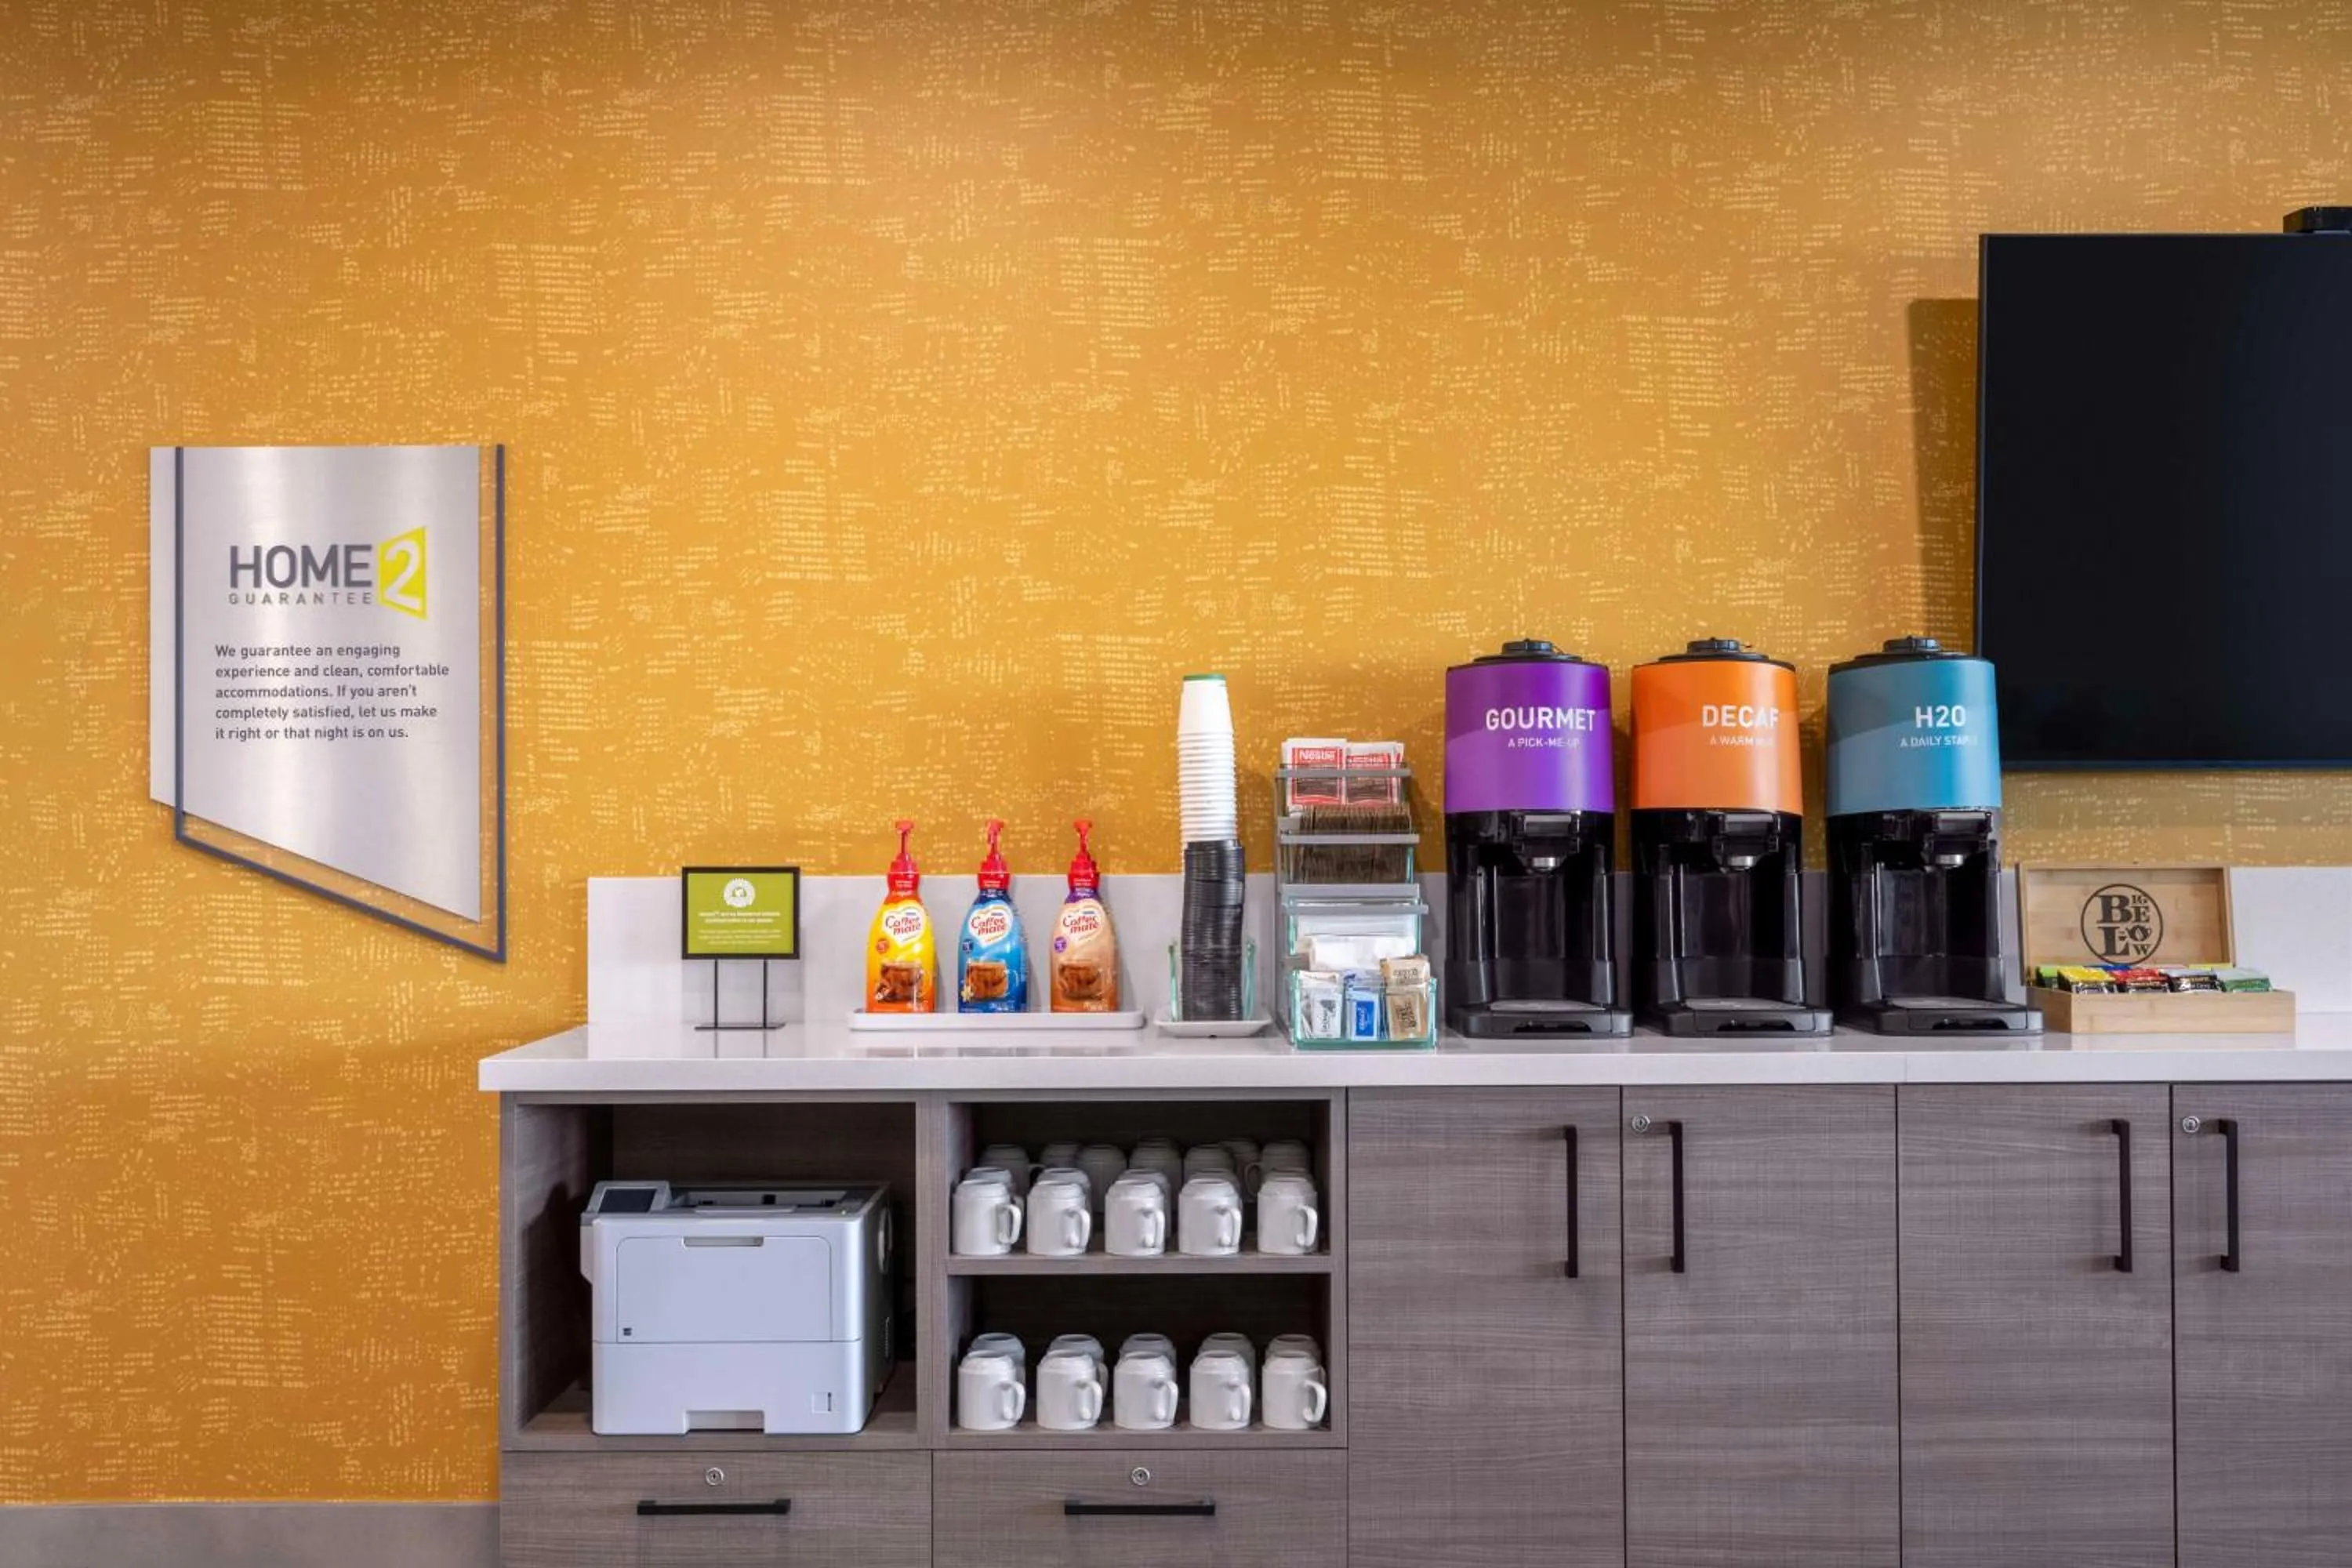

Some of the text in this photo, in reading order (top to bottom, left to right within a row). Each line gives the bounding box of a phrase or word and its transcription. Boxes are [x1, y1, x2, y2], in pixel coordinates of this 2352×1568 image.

[230, 545, 372, 589] HOME
[229, 592, 372, 604] GUARANTEE
[216, 644, 401, 659] We guarantee an engaging
[216, 663, 449, 680] experience and clean, comfortable
[216, 684, 417, 699] accommodations. If you aren't
[216, 706, 437, 720] completely satisfied, let us make
[1485, 706, 1595, 731] GOURMET
[1702, 705, 1779, 728] DECAF
[216, 726, 408, 742] it right or that night is on us.
[1710, 735, 1717, 746] A
[1720, 735, 1755, 746] WARM
[1508, 738, 1515, 747] A
[1900, 735, 1979, 747] A DAILY STAP
[971, 916, 1005, 928] Coffee
[1070, 923, 1098, 934] mate
[893, 923, 921, 935] mate
[978, 925, 1005, 935] mate
